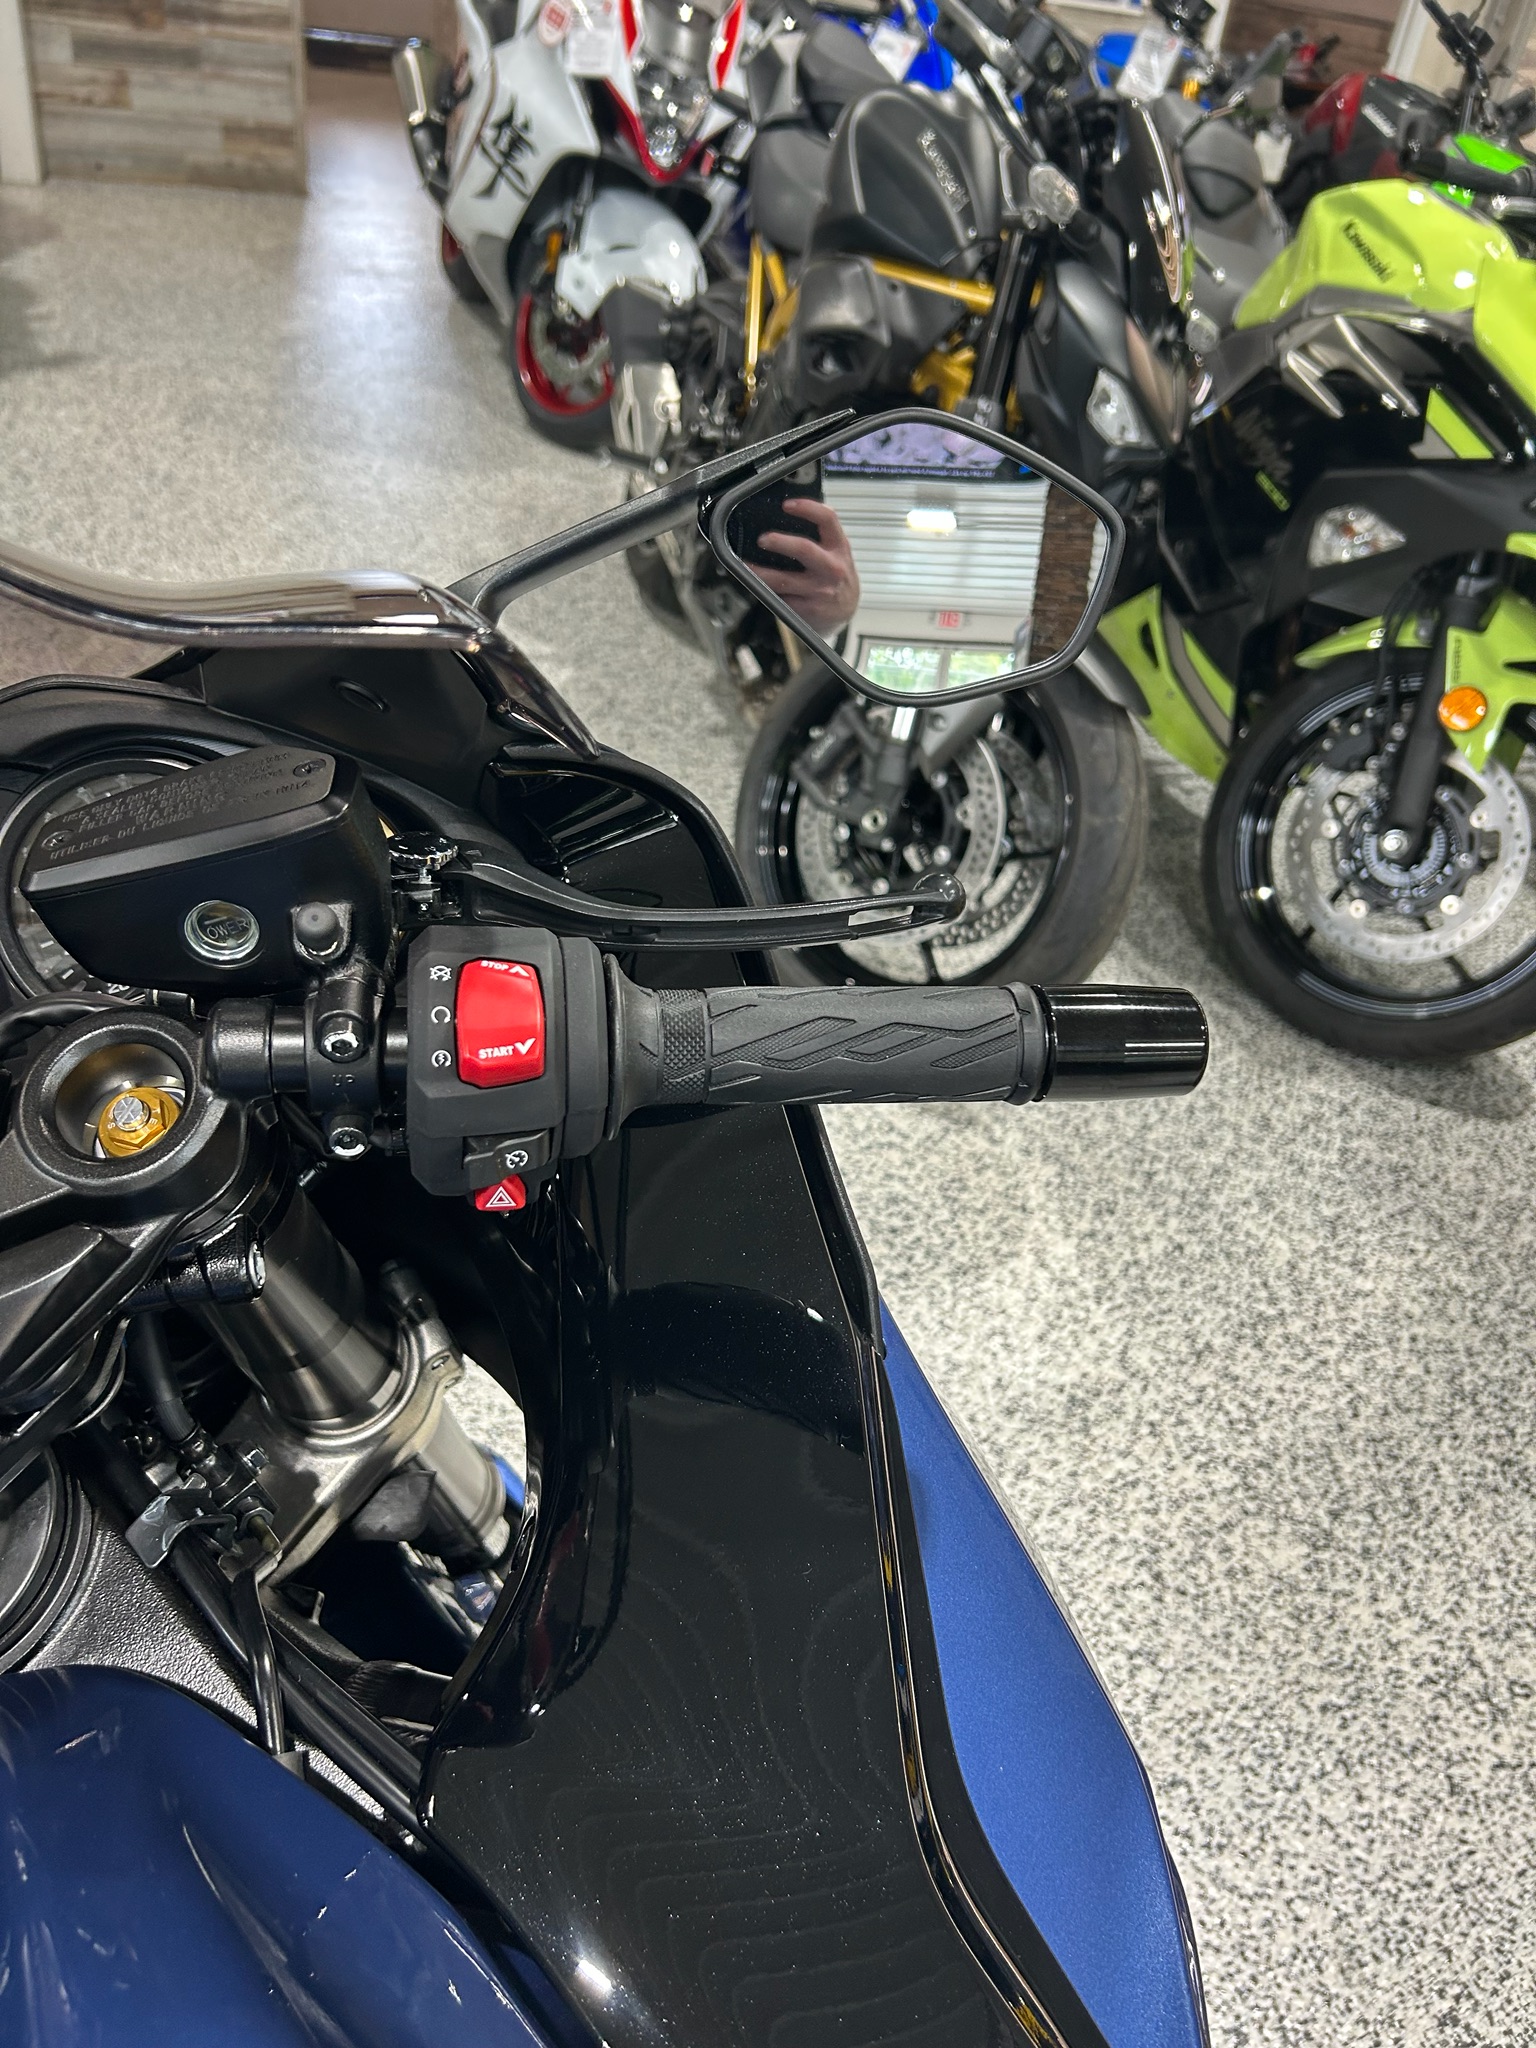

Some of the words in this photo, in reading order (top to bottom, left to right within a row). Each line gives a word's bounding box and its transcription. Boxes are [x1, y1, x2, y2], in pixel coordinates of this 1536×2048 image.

[206, 918, 250, 939] OWER
[480, 960, 509, 971] STOP
[478, 1045, 515, 1059] START
